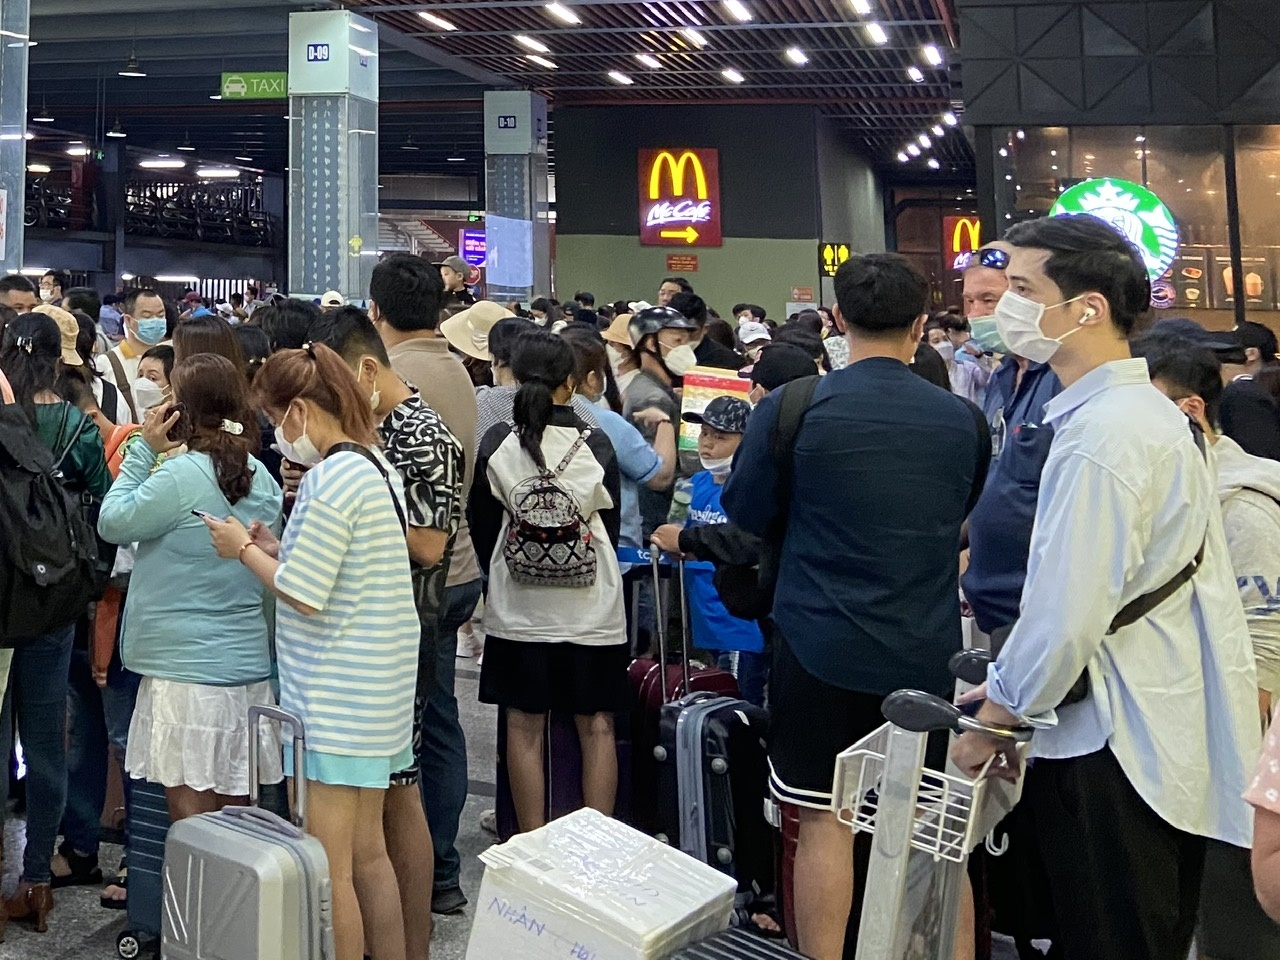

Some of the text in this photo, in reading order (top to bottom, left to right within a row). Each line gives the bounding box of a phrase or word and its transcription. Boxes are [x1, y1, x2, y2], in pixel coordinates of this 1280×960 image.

[308, 45, 329, 60] D-09
[251, 79, 285, 93] TAXI
[499, 117, 515, 128] D-10
[488, 897, 546, 937] NHÂN
